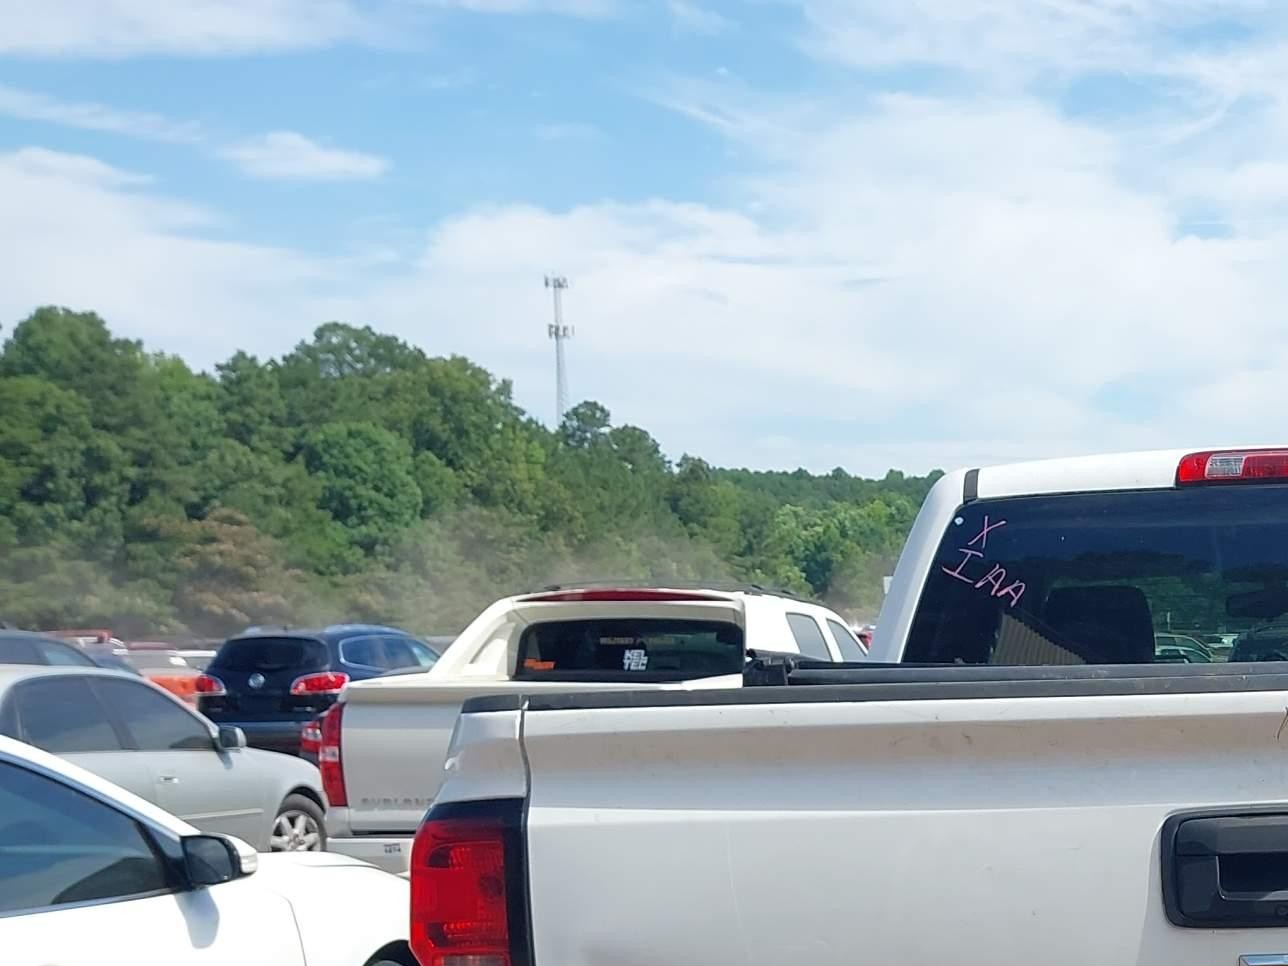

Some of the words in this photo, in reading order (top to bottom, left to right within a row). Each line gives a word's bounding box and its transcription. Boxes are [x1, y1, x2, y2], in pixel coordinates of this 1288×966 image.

[968, 515, 1007, 549] X
[942, 548, 1026, 607] IAA
[623, 656, 648, 671] TEC
